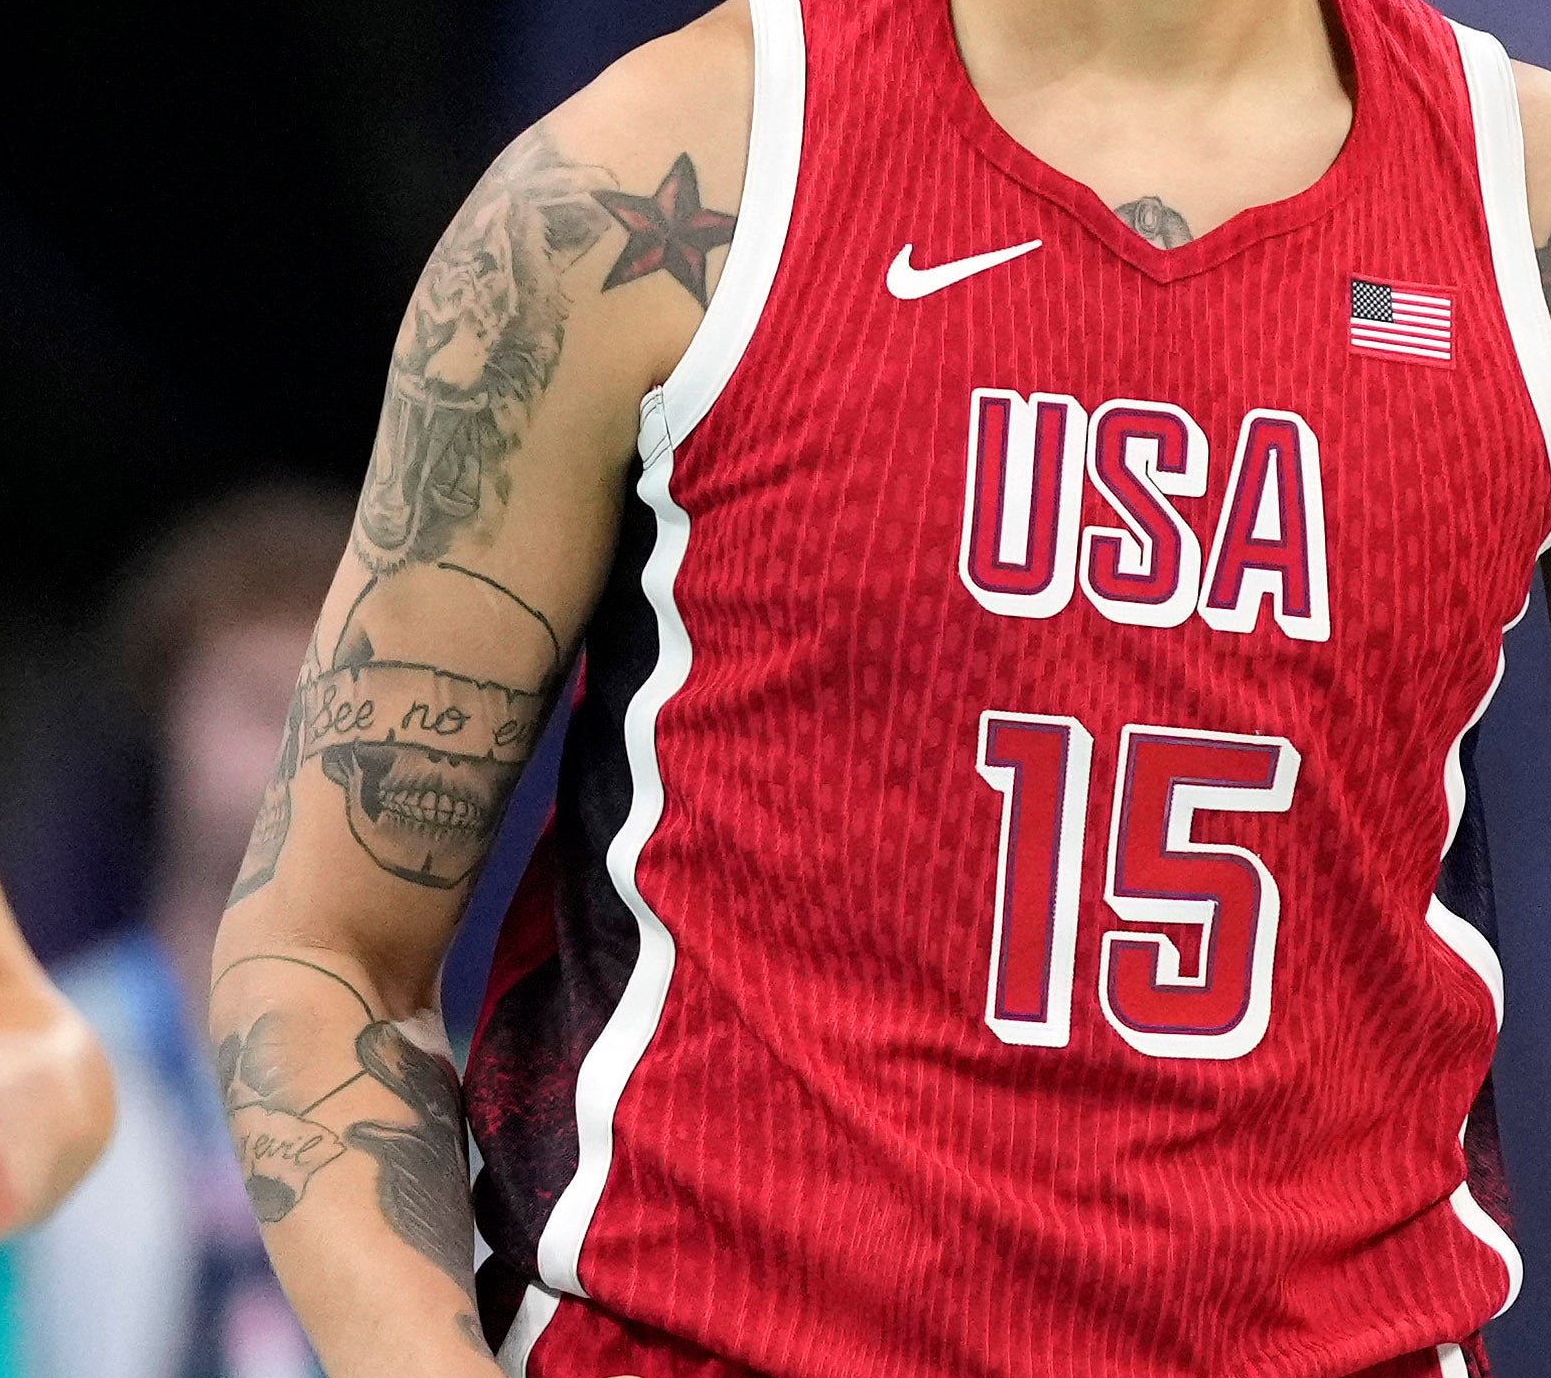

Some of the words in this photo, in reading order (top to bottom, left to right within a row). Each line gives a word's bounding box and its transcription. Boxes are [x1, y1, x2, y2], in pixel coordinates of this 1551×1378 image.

[959, 388, 1330, 642] USA
[310, 684, 377, 745] See
[401, 699, 472, 736] no
[976, 710, 1301, 1060] 15
